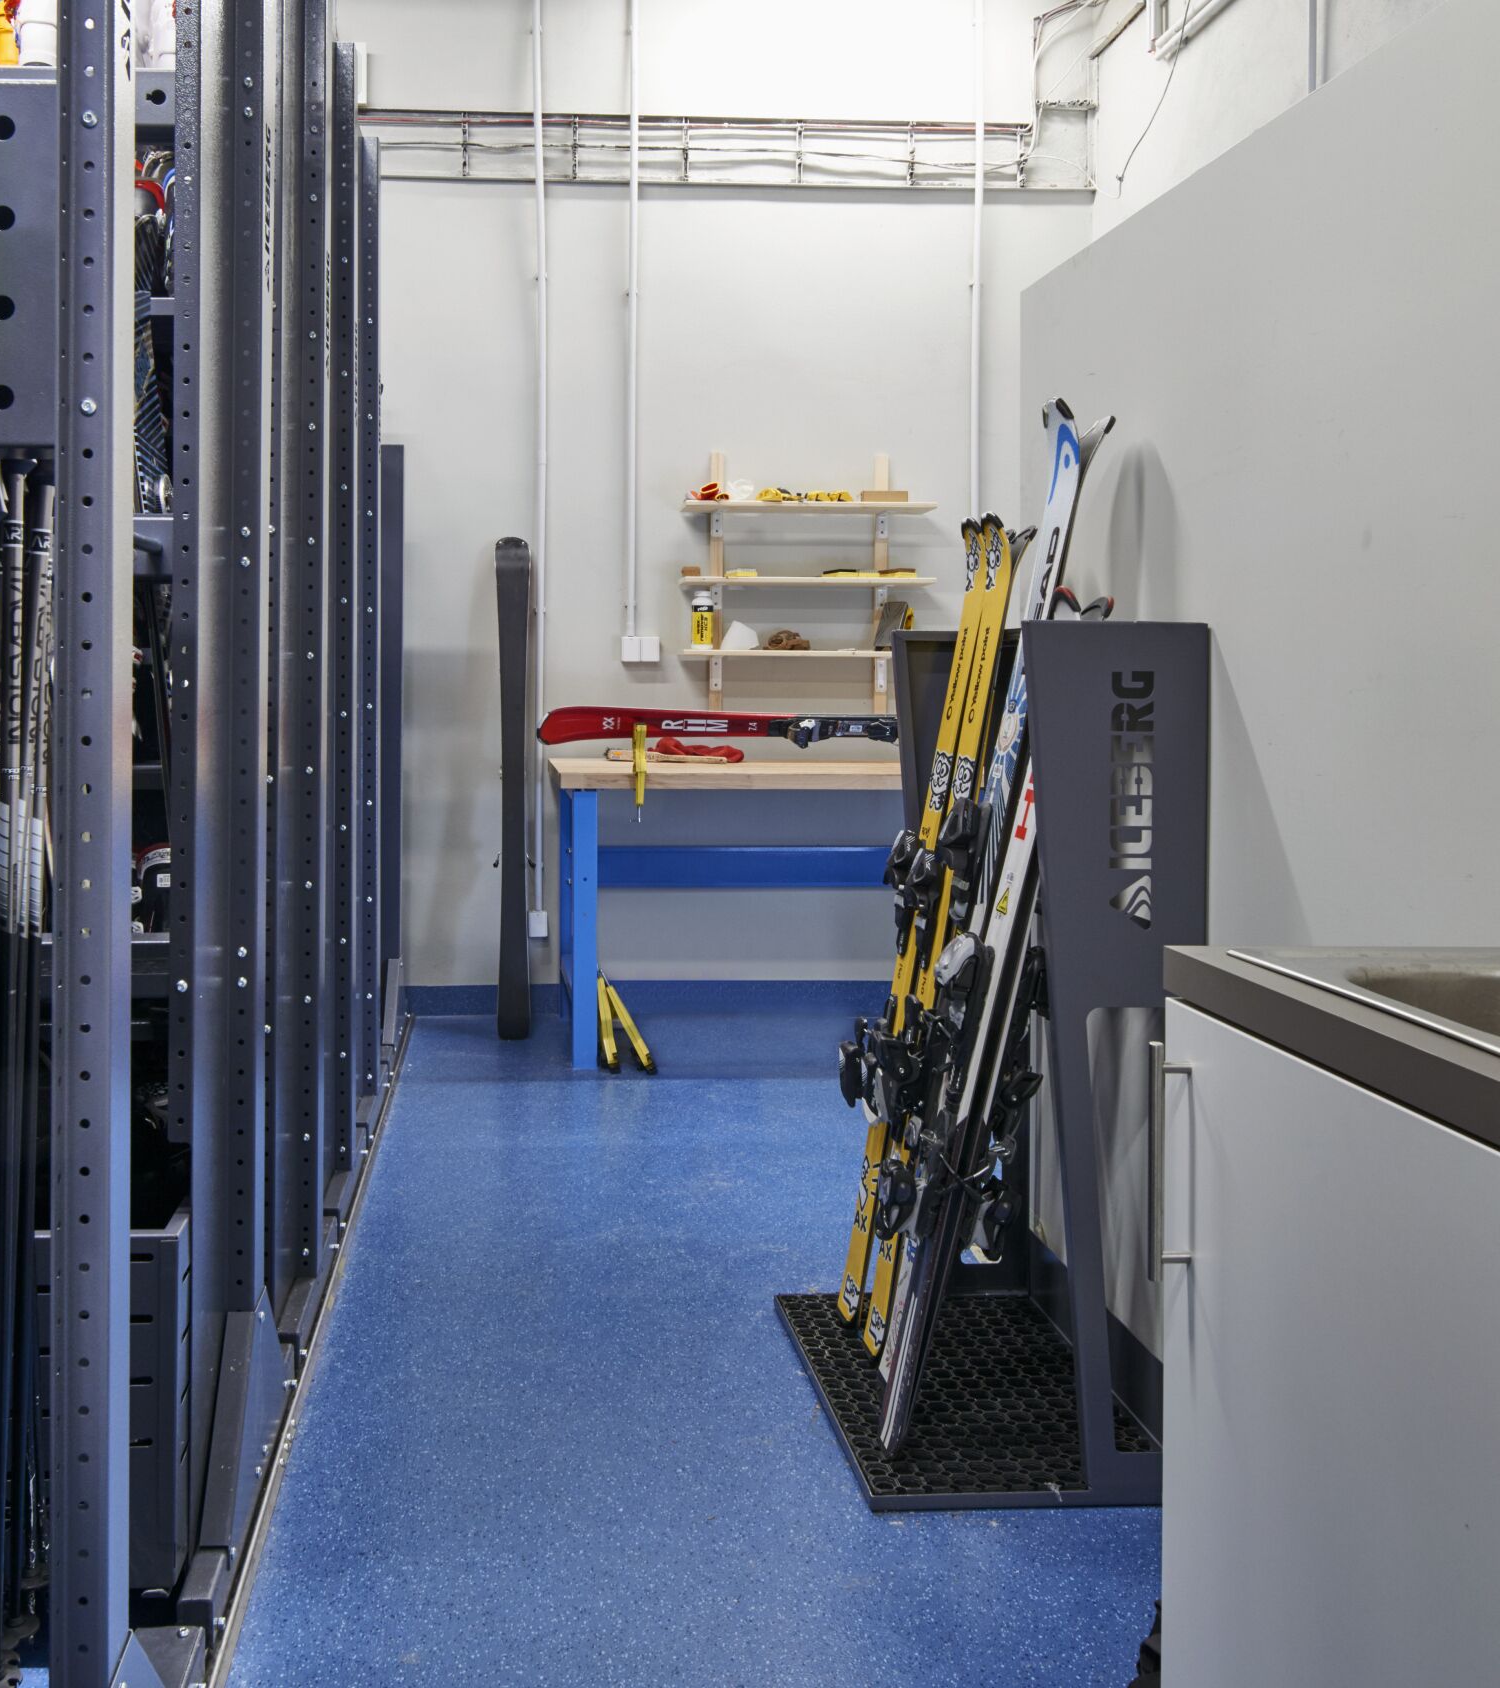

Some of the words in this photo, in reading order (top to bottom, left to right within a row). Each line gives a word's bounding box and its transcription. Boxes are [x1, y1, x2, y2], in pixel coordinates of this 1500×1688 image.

[264, 123, 273, 256] ICEBERG
[970, 663, 984, 707] Yellow
[977, 625, 991, 661] point
[1109, 671, 1155, 869] ICEBERG
